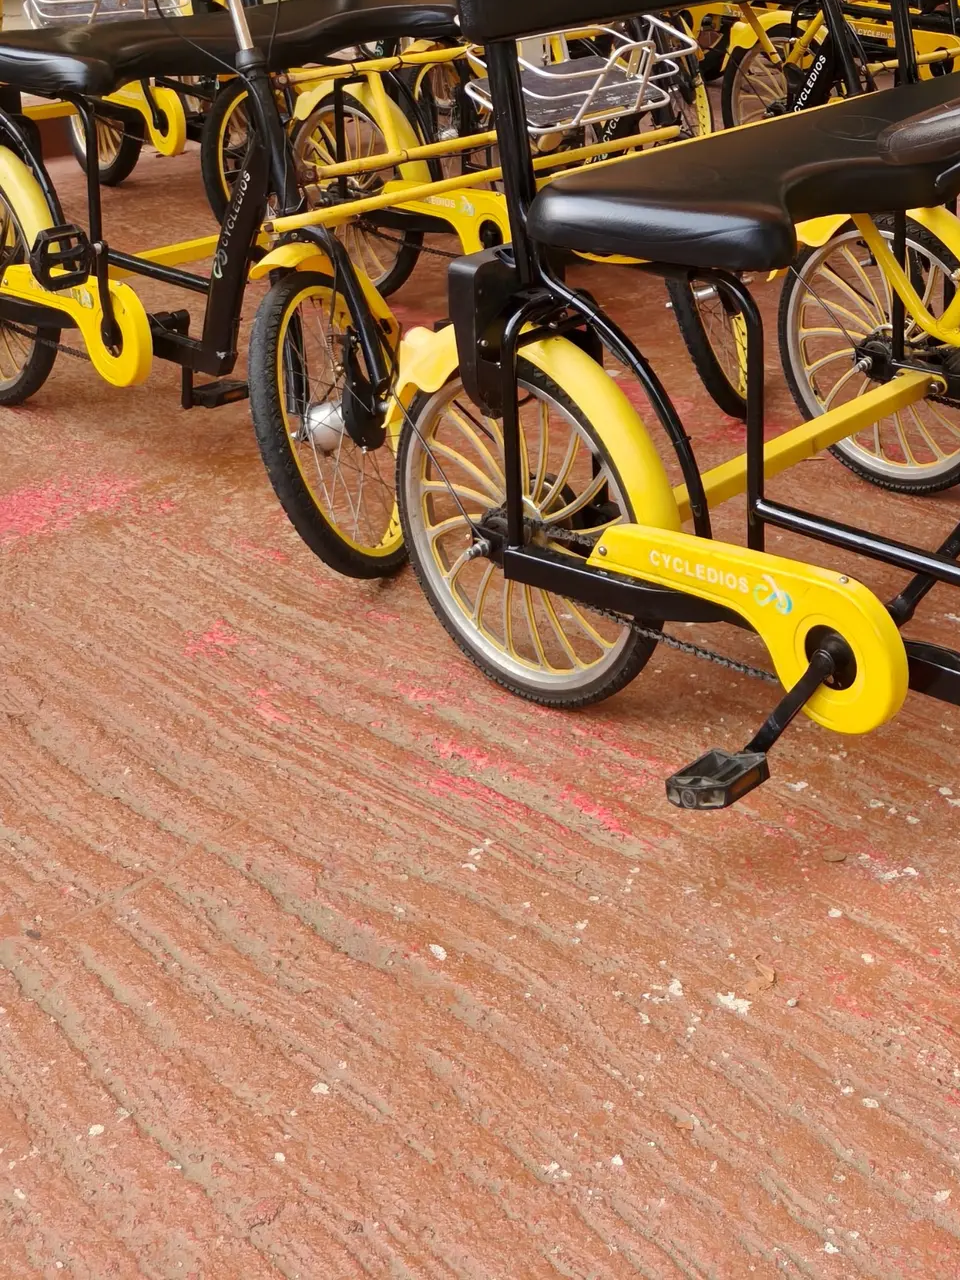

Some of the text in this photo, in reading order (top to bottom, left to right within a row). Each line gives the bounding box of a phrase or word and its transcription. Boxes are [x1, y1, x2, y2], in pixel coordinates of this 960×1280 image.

[857, 28, 893, 40] CYCLEDIO
[793, 55, 827, 113] CYCLEDIOS
[221, 169, 251, 247] CYCLEDIOS
[649, 549, 750, 593] CYCLEDIOS
